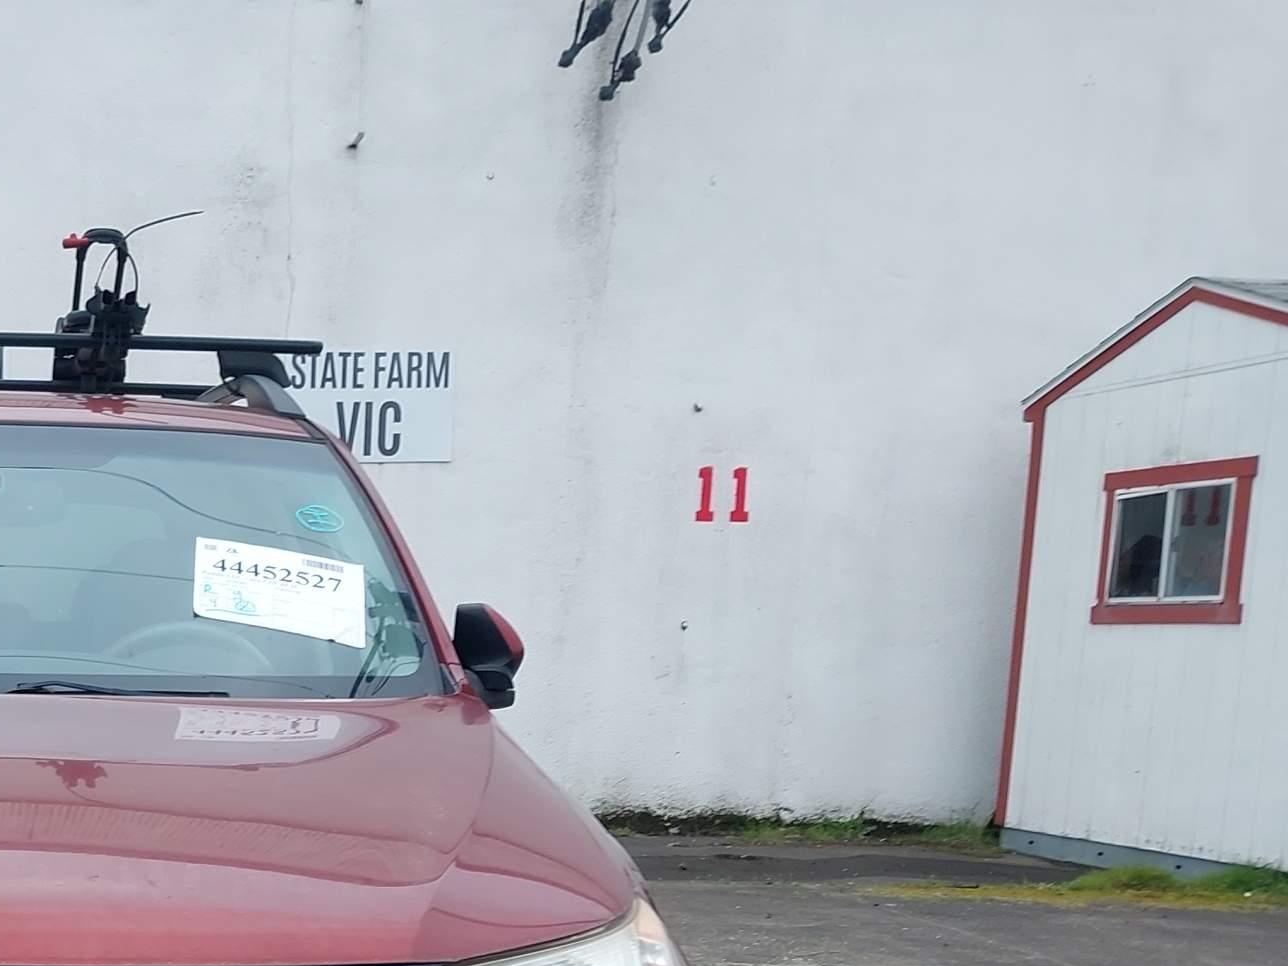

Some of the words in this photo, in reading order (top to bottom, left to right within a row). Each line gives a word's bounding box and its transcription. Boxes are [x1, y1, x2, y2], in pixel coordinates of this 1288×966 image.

[291, 352, 365, 389] STATE
[373, 352, 450, 389] FARM
[336, 401, 402, 456] VIC
[695, 466, 749, 522] 11
[212, 559, 342, 593] 44452527
